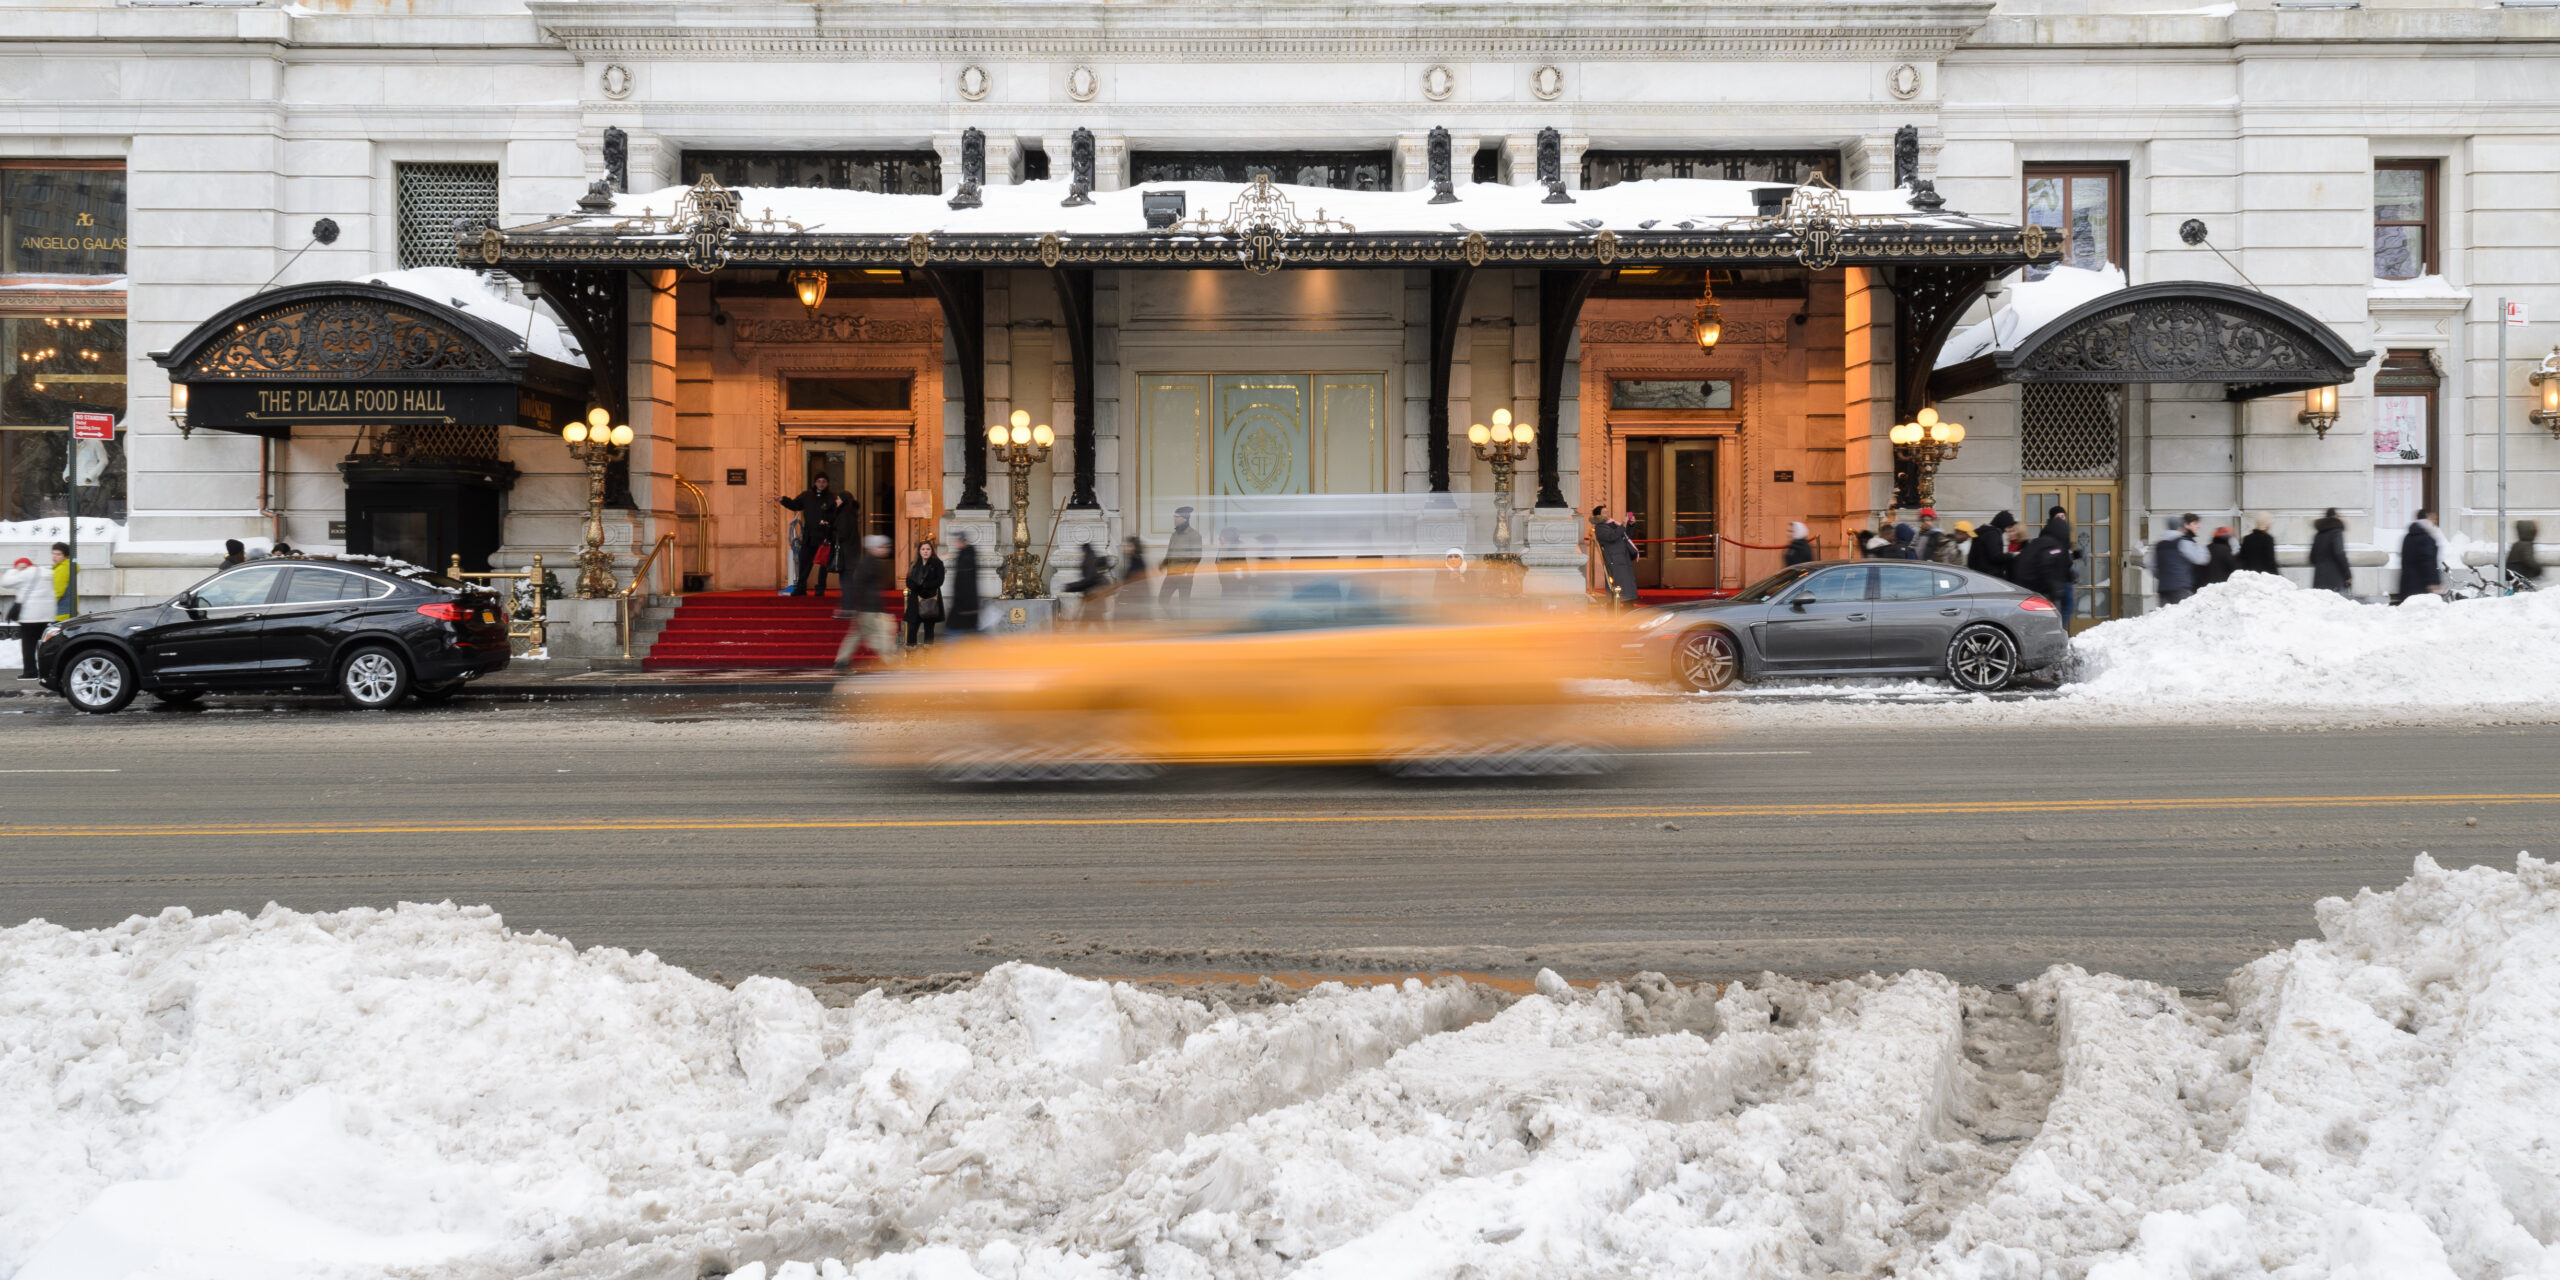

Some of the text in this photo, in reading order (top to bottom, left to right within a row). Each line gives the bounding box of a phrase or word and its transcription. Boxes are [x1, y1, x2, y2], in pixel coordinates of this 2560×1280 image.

[21, 237, 80, 250] ANGELO
[258, 389, 446, 412] THE PLAZA FOOD HALL
